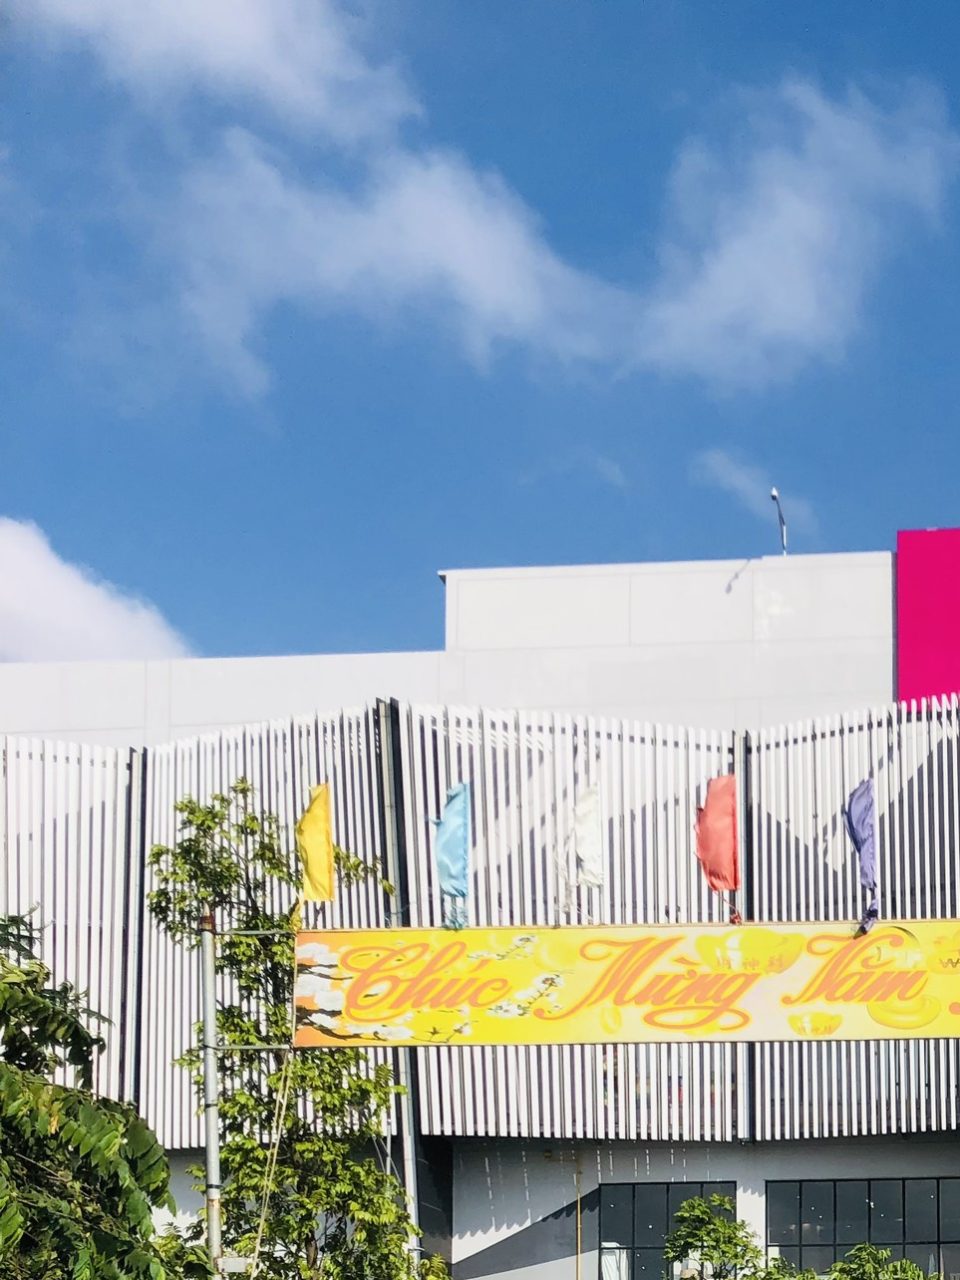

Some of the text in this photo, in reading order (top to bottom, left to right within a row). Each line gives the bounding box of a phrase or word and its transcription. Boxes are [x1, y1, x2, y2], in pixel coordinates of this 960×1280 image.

[339, 940, 511, 1023] Chúc
[533, 936, 761, 1031] Mừng
[781, 933, 929, 1004] Năm
